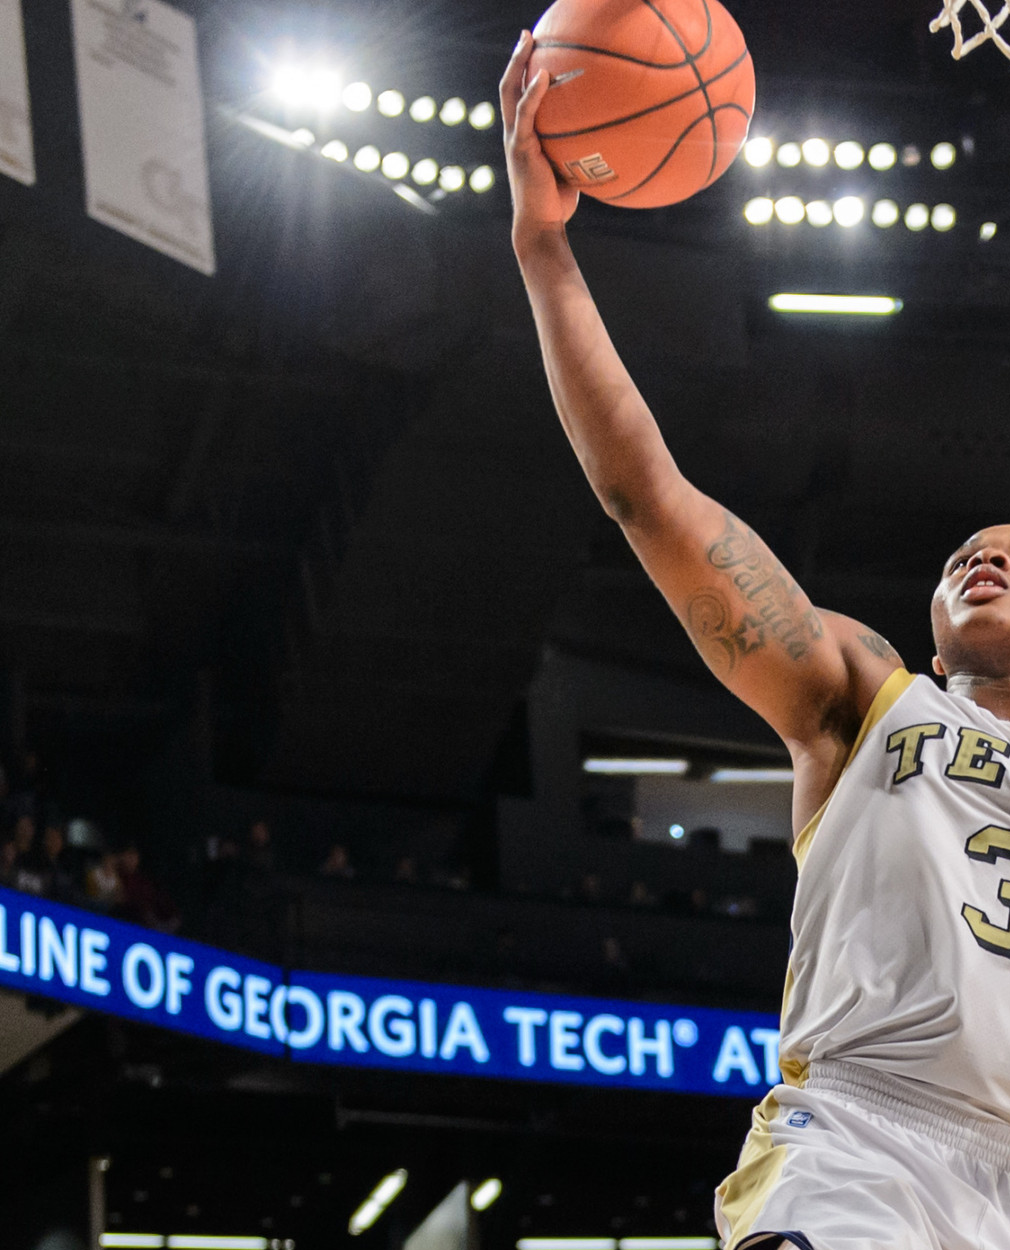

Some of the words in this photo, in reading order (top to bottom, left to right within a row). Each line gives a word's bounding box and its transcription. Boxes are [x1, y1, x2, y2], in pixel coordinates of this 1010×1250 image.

[0, 903, 112, 996] LINE
[122, 942, 195, 1015] OF
[204, 966, 491, 1064] GEORGIA
